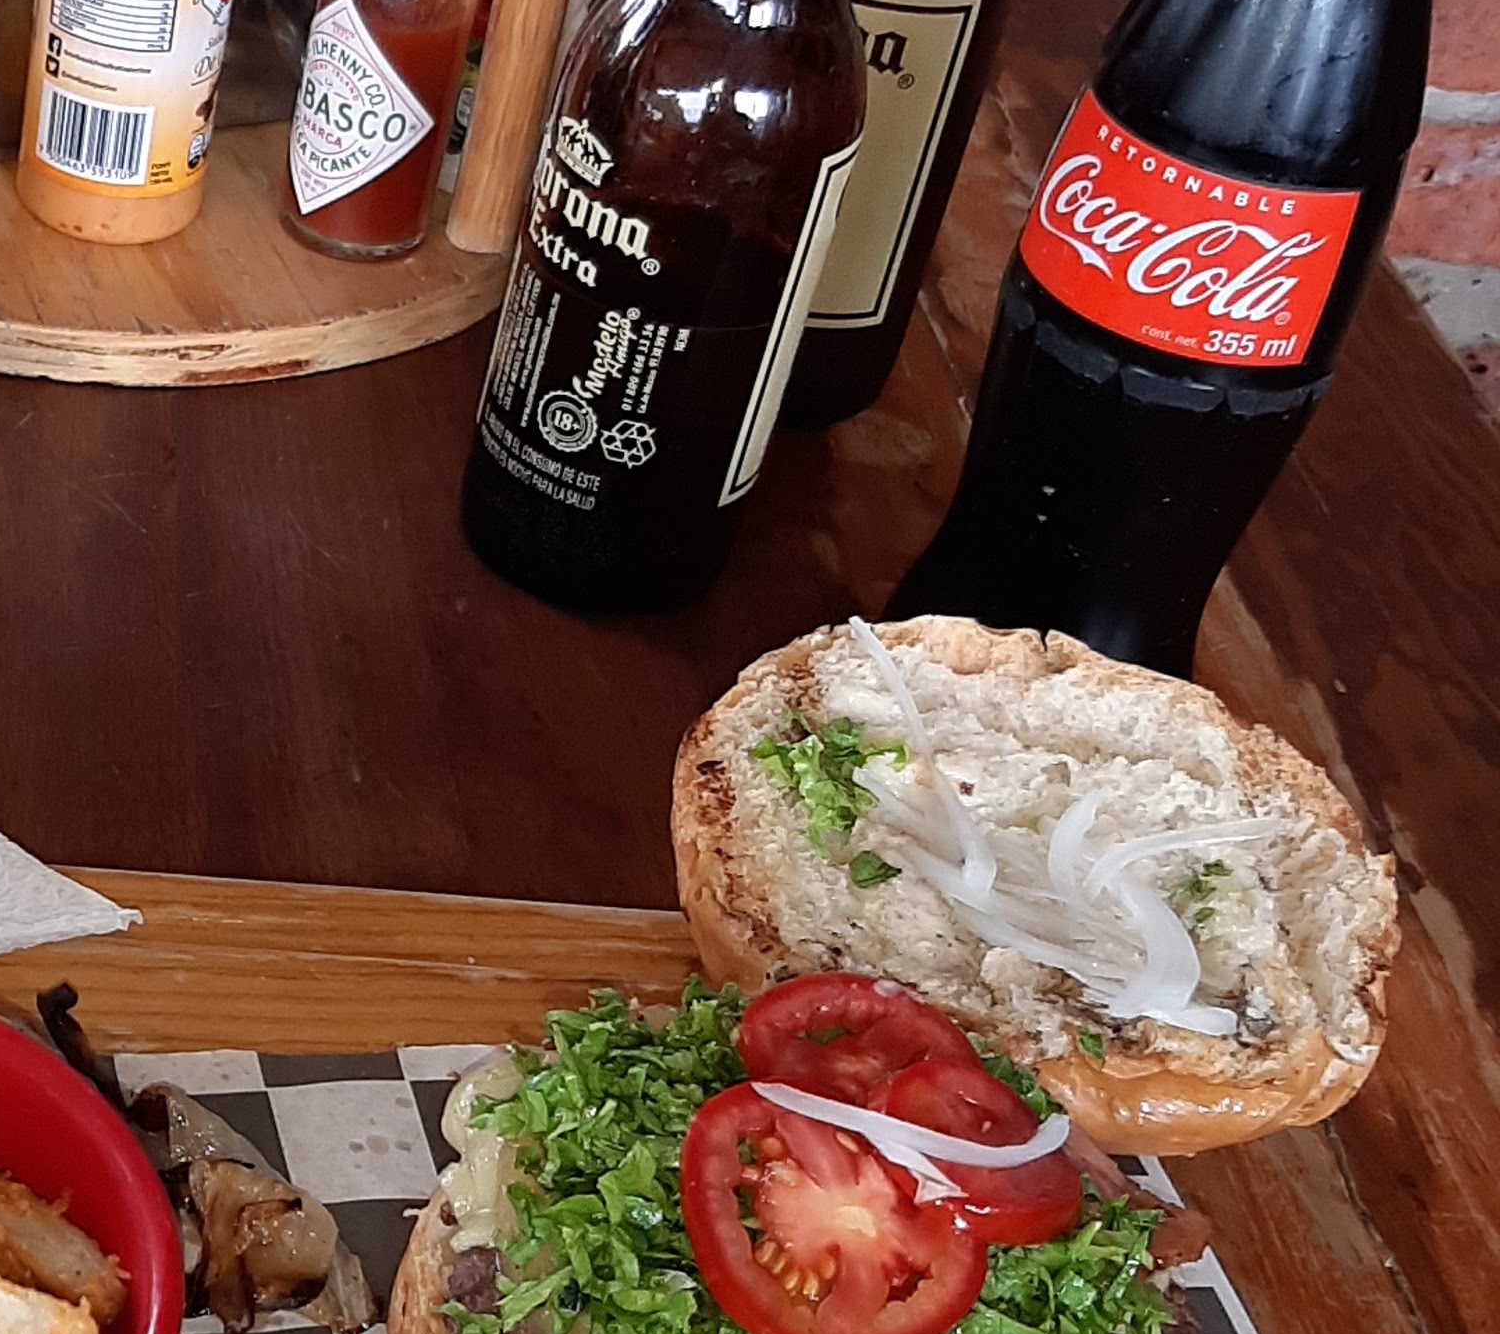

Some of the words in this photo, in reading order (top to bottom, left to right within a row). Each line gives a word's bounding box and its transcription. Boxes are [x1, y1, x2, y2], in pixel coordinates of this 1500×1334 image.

[302, 77, 406, 143] BASCO
[308, 145, 372, 173] PICANTE
[1097, 124, 1297, 216] RETORNABLE
[529, 197, 598, 288] Extra
[1040, 154, 1330, 322] Coca-Cola
[1203, 330, 1257, 357] 355
[1261, 334, 1298, 358] ml
